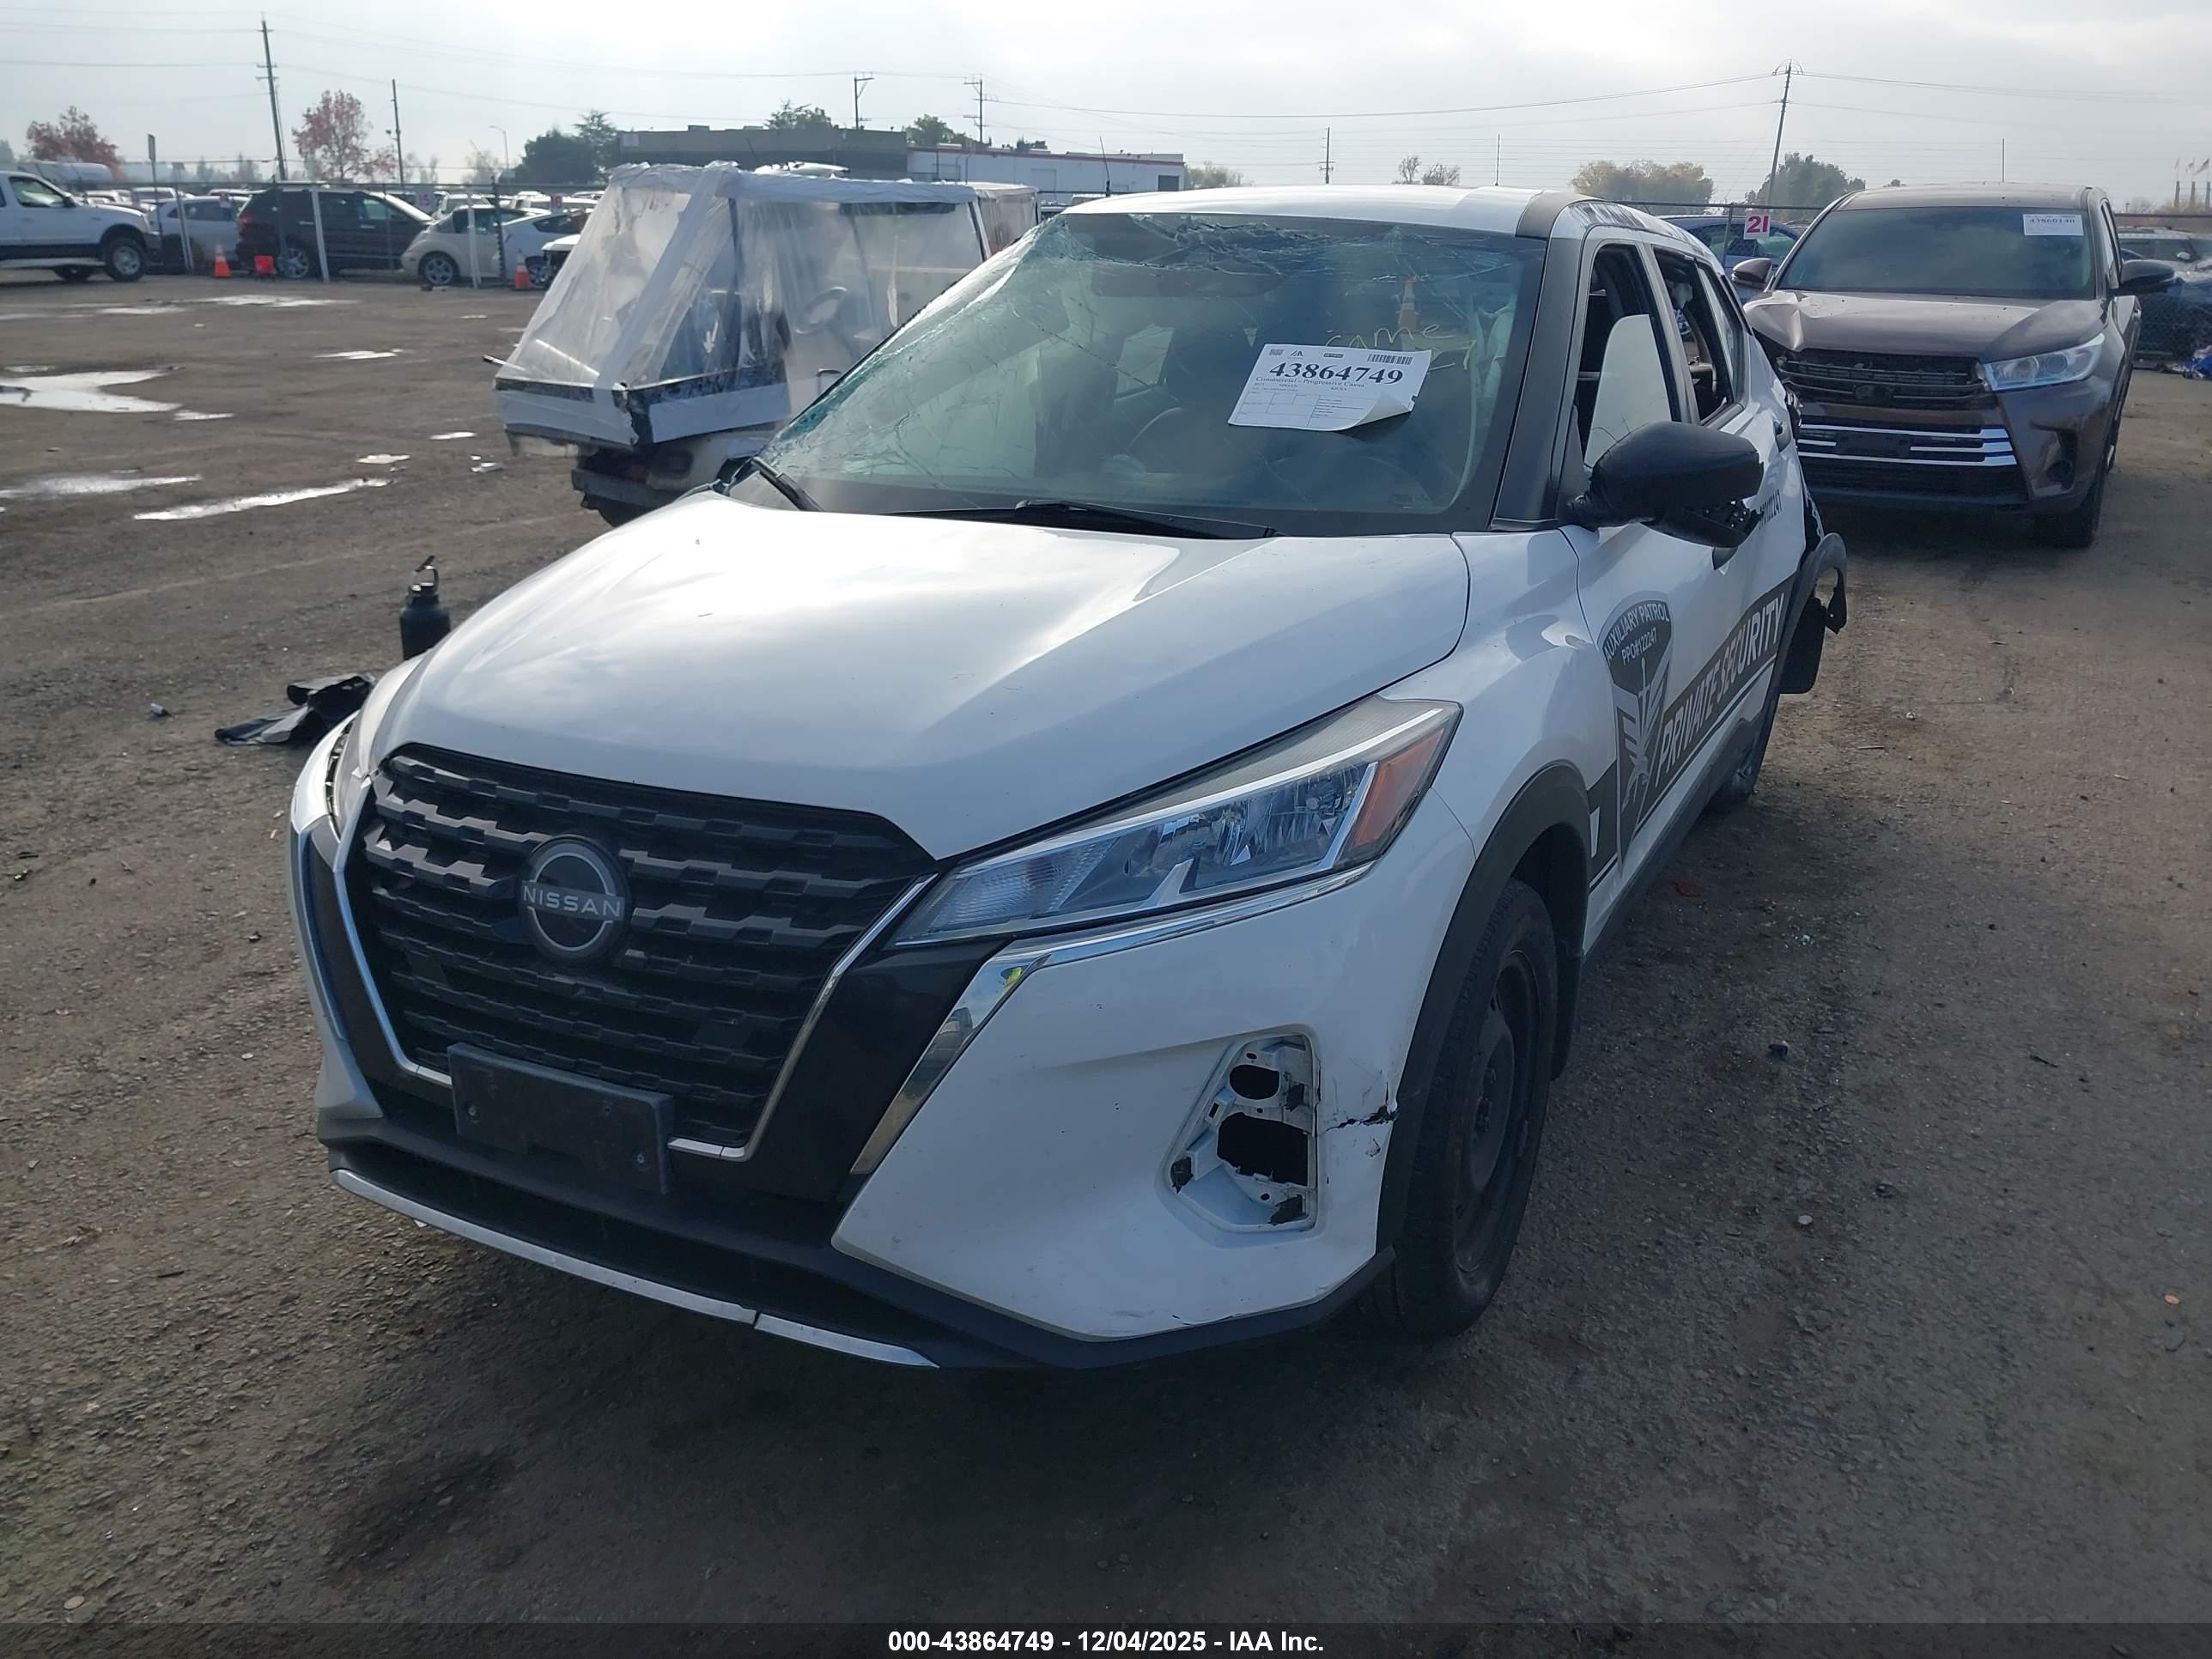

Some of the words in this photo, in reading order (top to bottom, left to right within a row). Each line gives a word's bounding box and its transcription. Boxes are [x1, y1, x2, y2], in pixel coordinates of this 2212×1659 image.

[1746, 216, 1769, 233] 21
[1269, 362, 1403, 384] 43864749
[1302, 378, 1343, 387] Progressive
[1604, 609, 1640, 666] AUXILIARY
[1638, 603, 1670, 623] PATROL
[1655, 665, 1721, 789] PRIVATE
[1717, 592, 1785, 703] SECURITY
[523, 885, 621, 917] NISSAN
